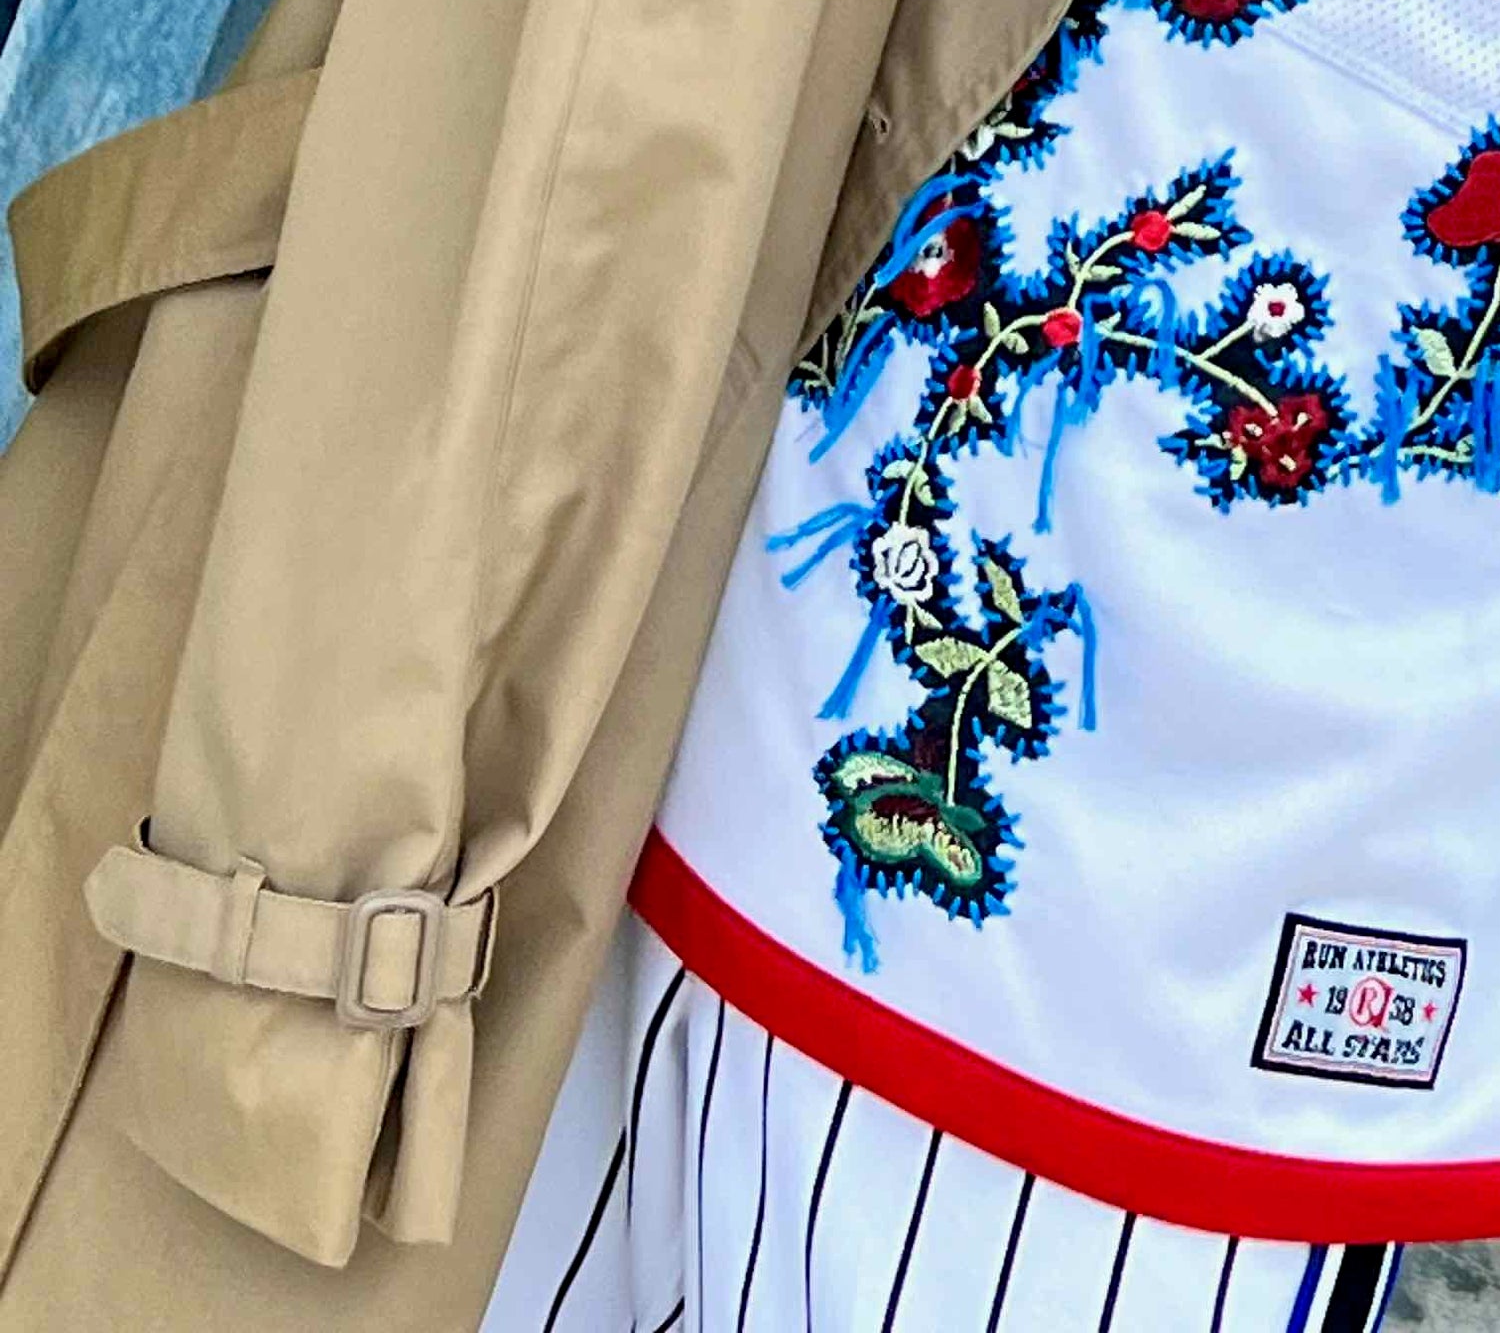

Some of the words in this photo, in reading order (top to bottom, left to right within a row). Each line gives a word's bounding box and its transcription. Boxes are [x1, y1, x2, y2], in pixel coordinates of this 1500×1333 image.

[1301, 941, 1349, 971] RUN
[1352, 948, 1446, 988] ATHLETICS
[1281, 1019, 1335, 1055] ALL
[1343, 1034, 1426, 1065] STARS
